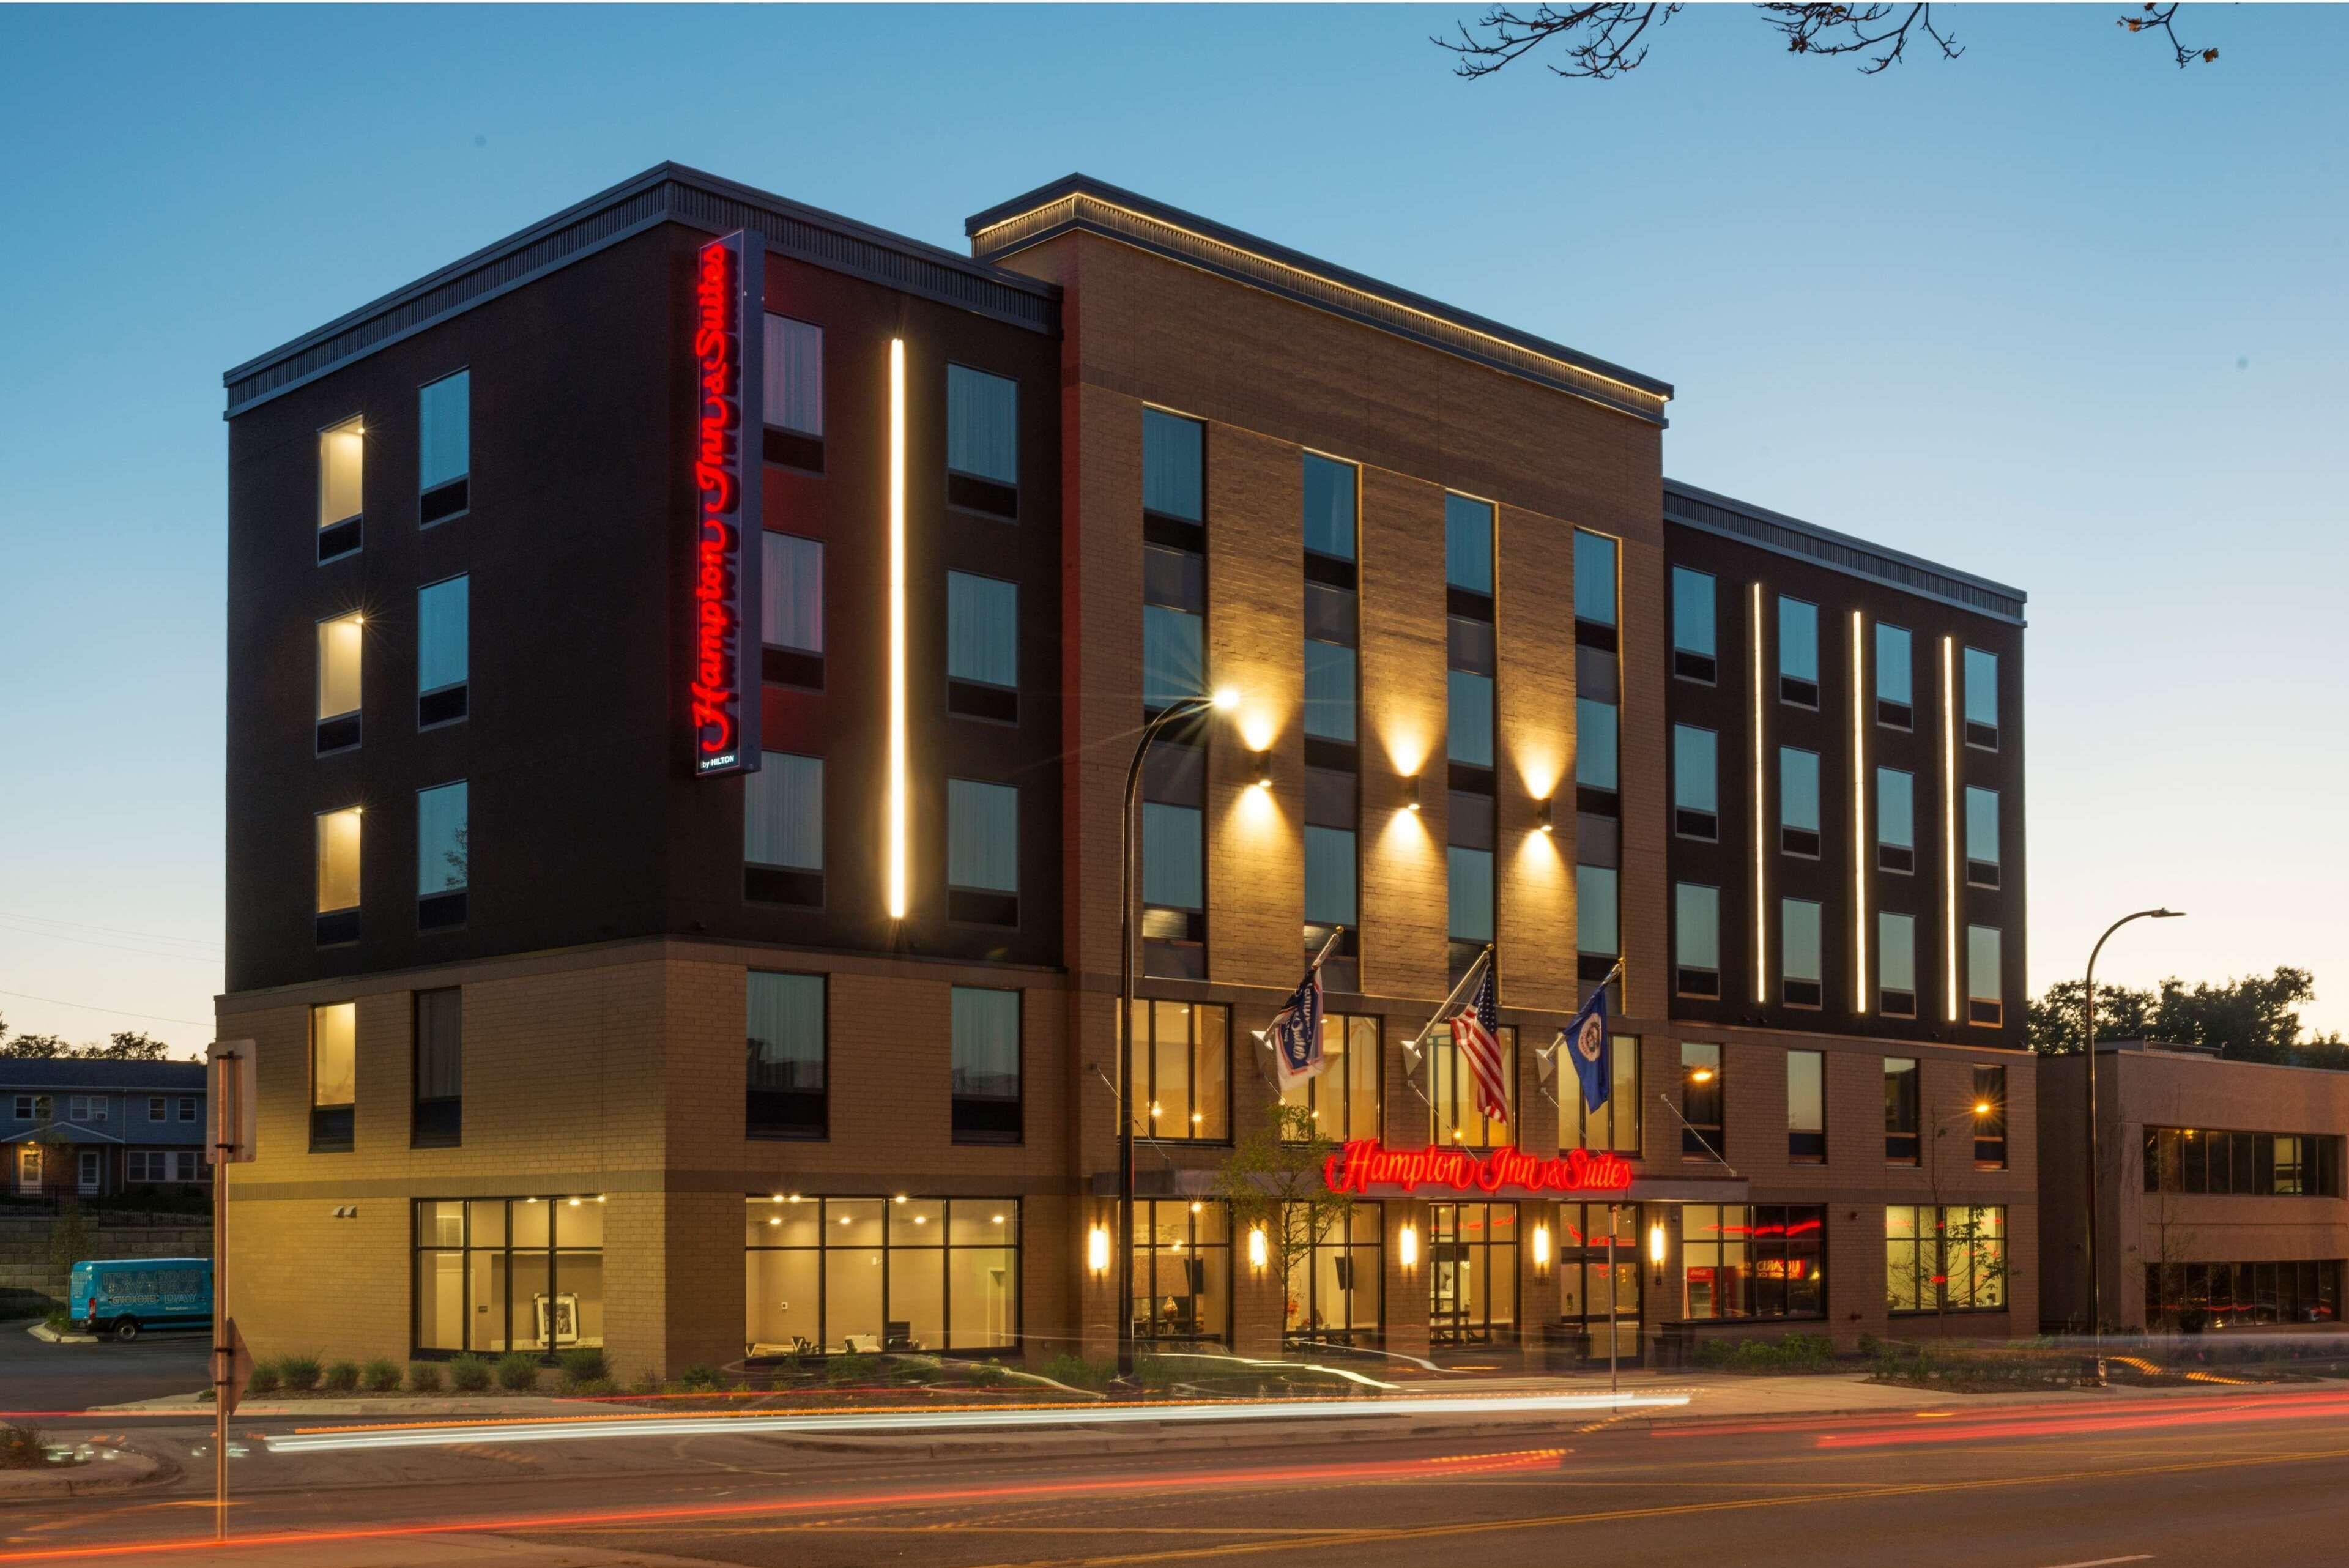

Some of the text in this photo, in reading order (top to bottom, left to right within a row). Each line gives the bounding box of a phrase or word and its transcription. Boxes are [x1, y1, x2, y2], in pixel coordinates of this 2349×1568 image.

[692, 243, 730, 752] Hampton Inn & Suites
[702, 754, 735, 769] by HILTON
[1324, 1138, 1633, 1194] Hampton Inn & Suites
[103, 1272, 132, 1285] IT'S
[137, 1271, 150, 1284] A
[109, 1282, 143, 1294] DAY
[109, 1293, 197, 1306] GOOD DAY
